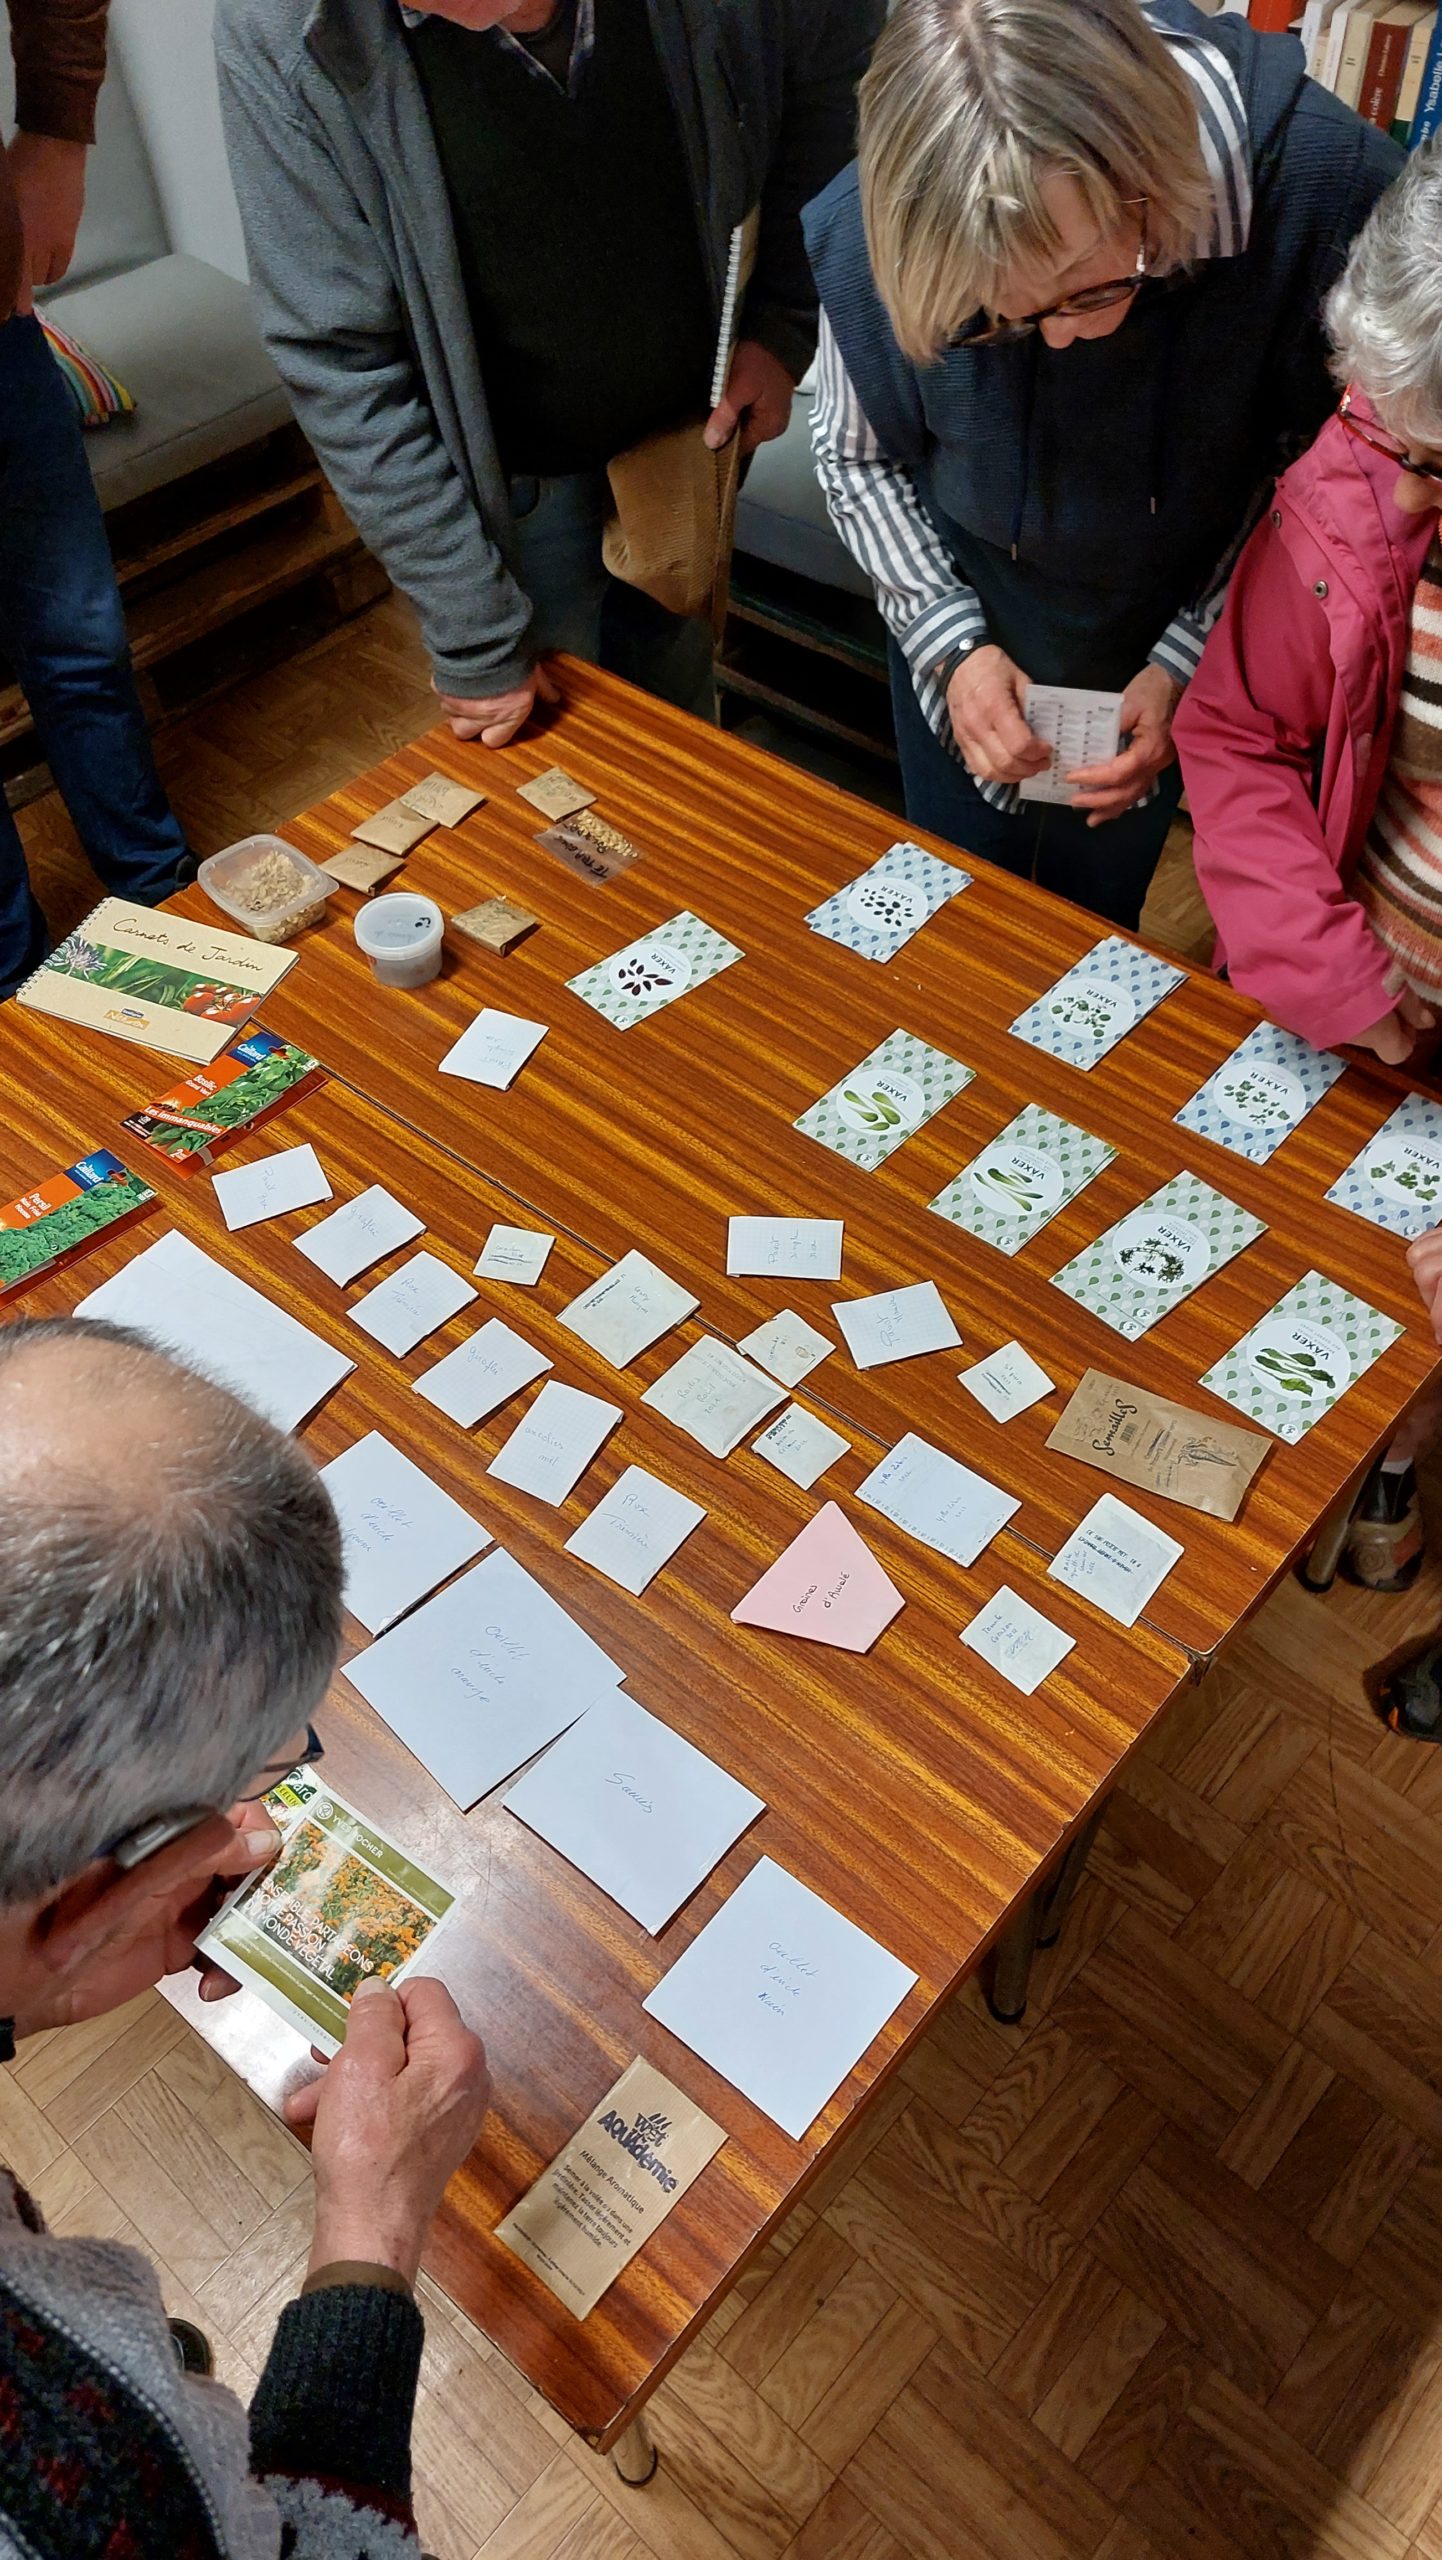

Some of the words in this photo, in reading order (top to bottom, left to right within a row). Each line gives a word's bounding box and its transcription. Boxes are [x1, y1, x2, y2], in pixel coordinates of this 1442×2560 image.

[113, 918, 169, 945] Carnets
[176, 940, 195, 954] de
[202, 946, 263, 972] Jardin
[144, 1106, 160, 1118] Les
[29, 1192, 52, 1212] Persil
[792, 1583, 818, 1614] Graines
[255, 1909, 298, 1947] MONDE
[282, 1912, 327, 1952] PASSION
[578, 2150, 608, 2180] Mélange
[606, 2175, 646, 2215] Aromatique
[577, 2192, 598, 2212] Tasser
[608, 2208, 624, 2224] dans
[620, 2221, 634, 2234] une
[593, 2223, 620, 2249] toujours
